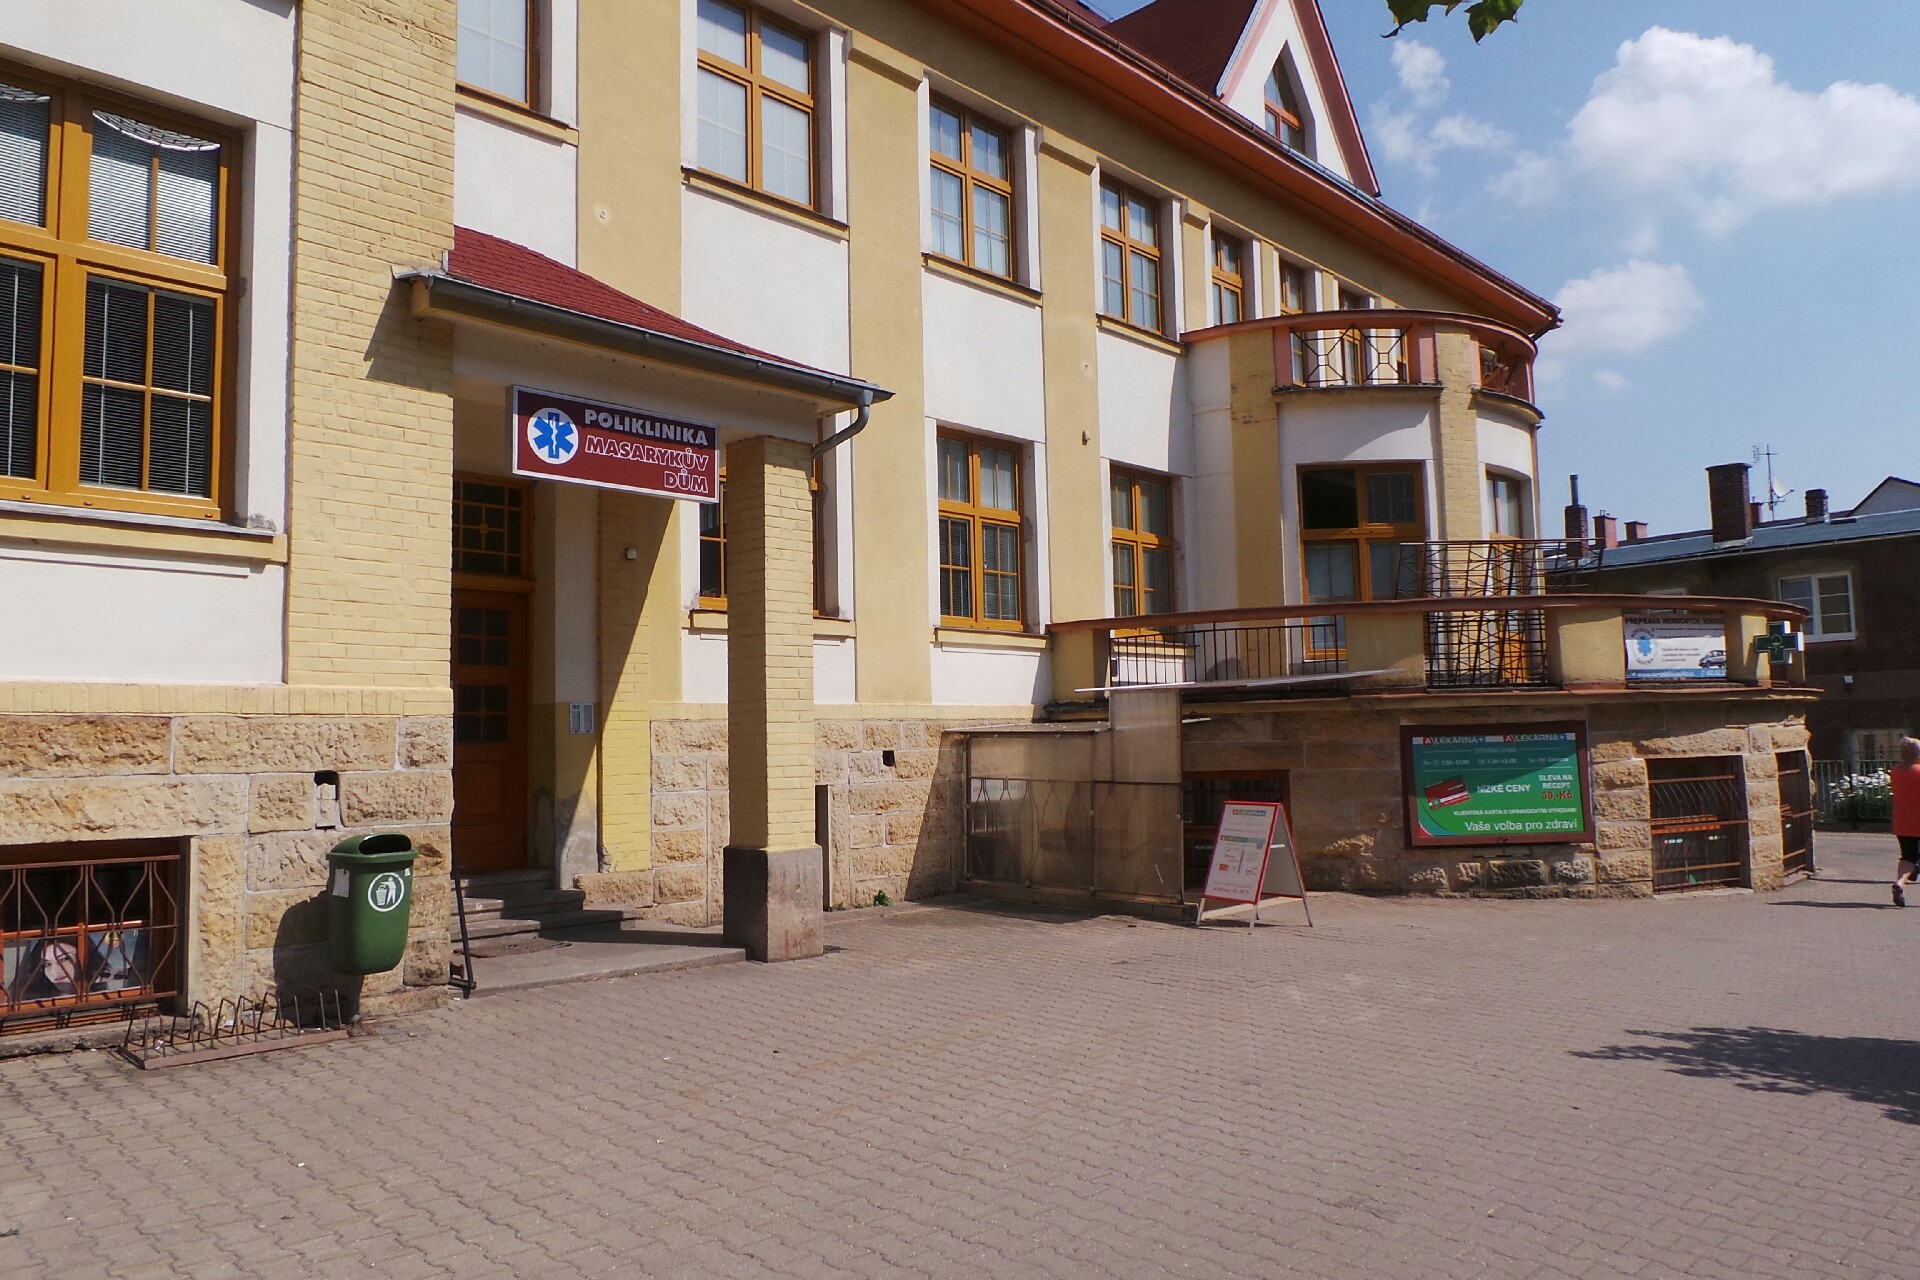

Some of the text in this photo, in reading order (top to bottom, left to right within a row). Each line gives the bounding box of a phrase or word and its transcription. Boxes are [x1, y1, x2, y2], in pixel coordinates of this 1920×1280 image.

[585, 408, 708, 446] POLIKLINIKA
[585, 435, 709, 472] MASARYKŮV
[664, 468, 709, 493] DŮM
[1505, 784, 1531, 793] CENY
[1464, 821, 1491, 831] Vaše
[1493, 820, 1523, 831] volba
[1525, 821, 1543, 832] pro
